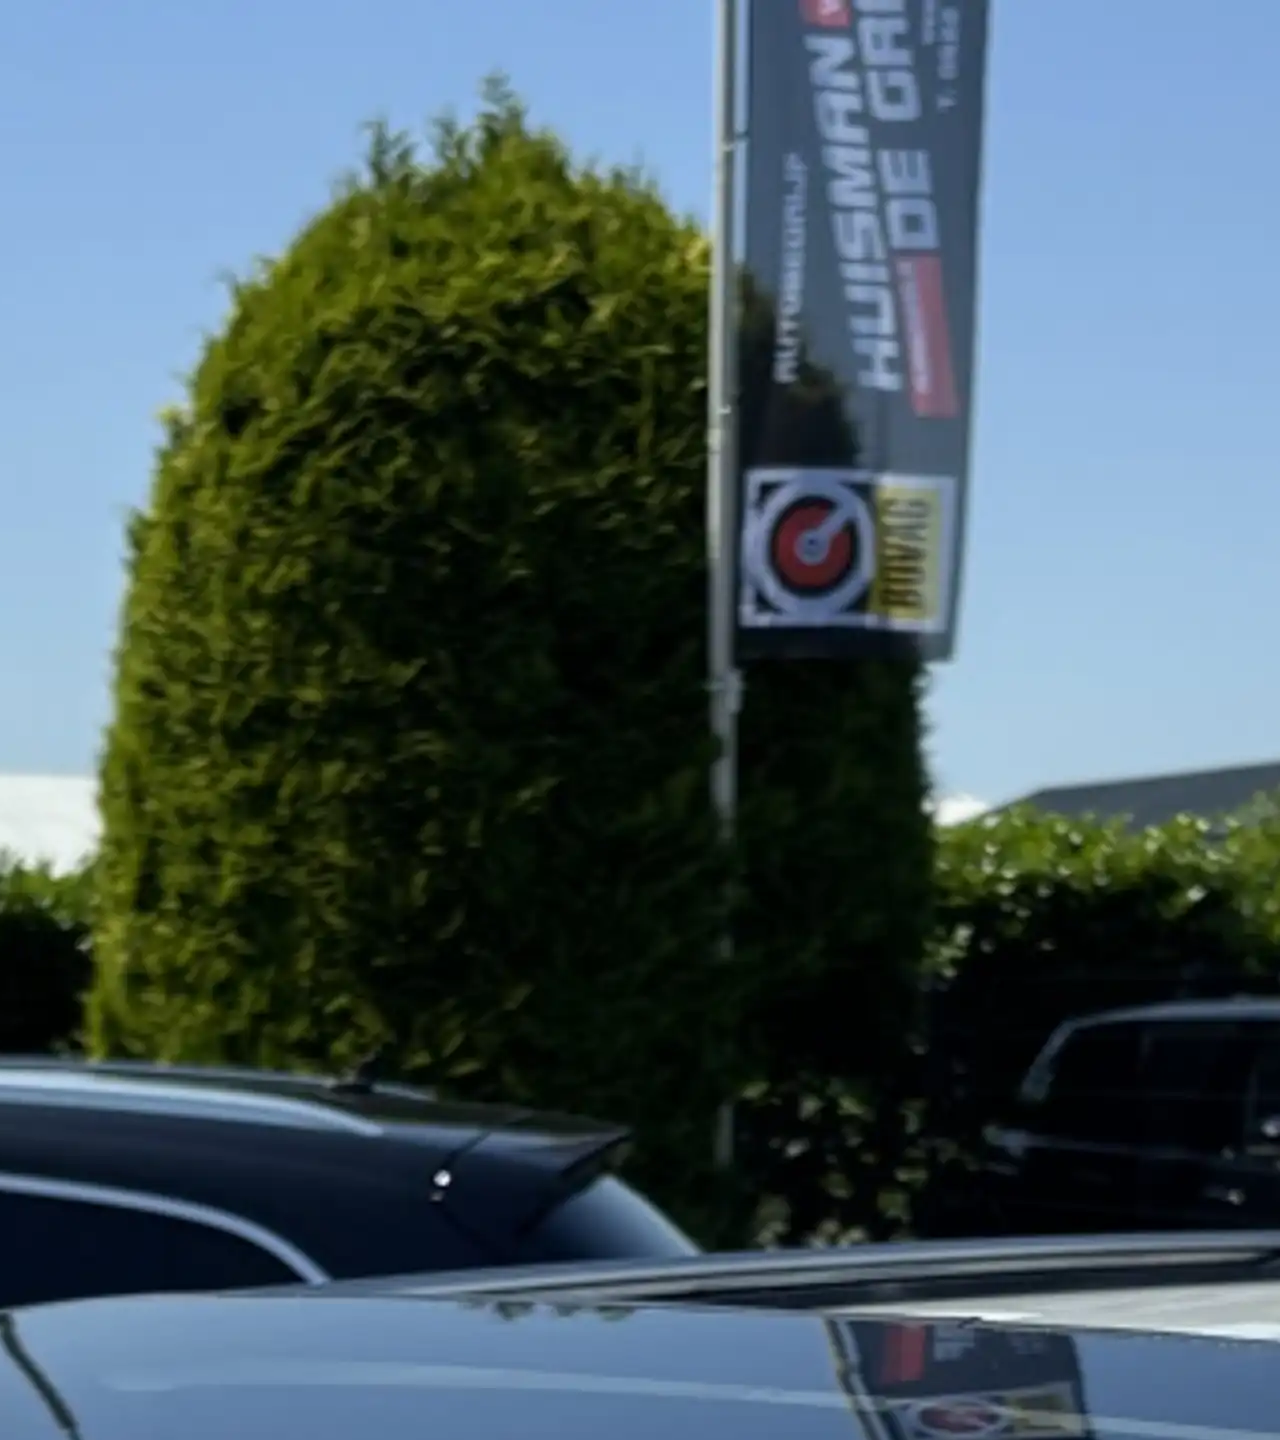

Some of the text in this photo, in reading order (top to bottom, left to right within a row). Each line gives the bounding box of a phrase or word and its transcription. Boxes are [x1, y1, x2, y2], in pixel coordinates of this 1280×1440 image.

[852, 0, 922, 121] GA
[803, 34, 903, 391] HUISMAN
[876, 149, 939, 250] DE
